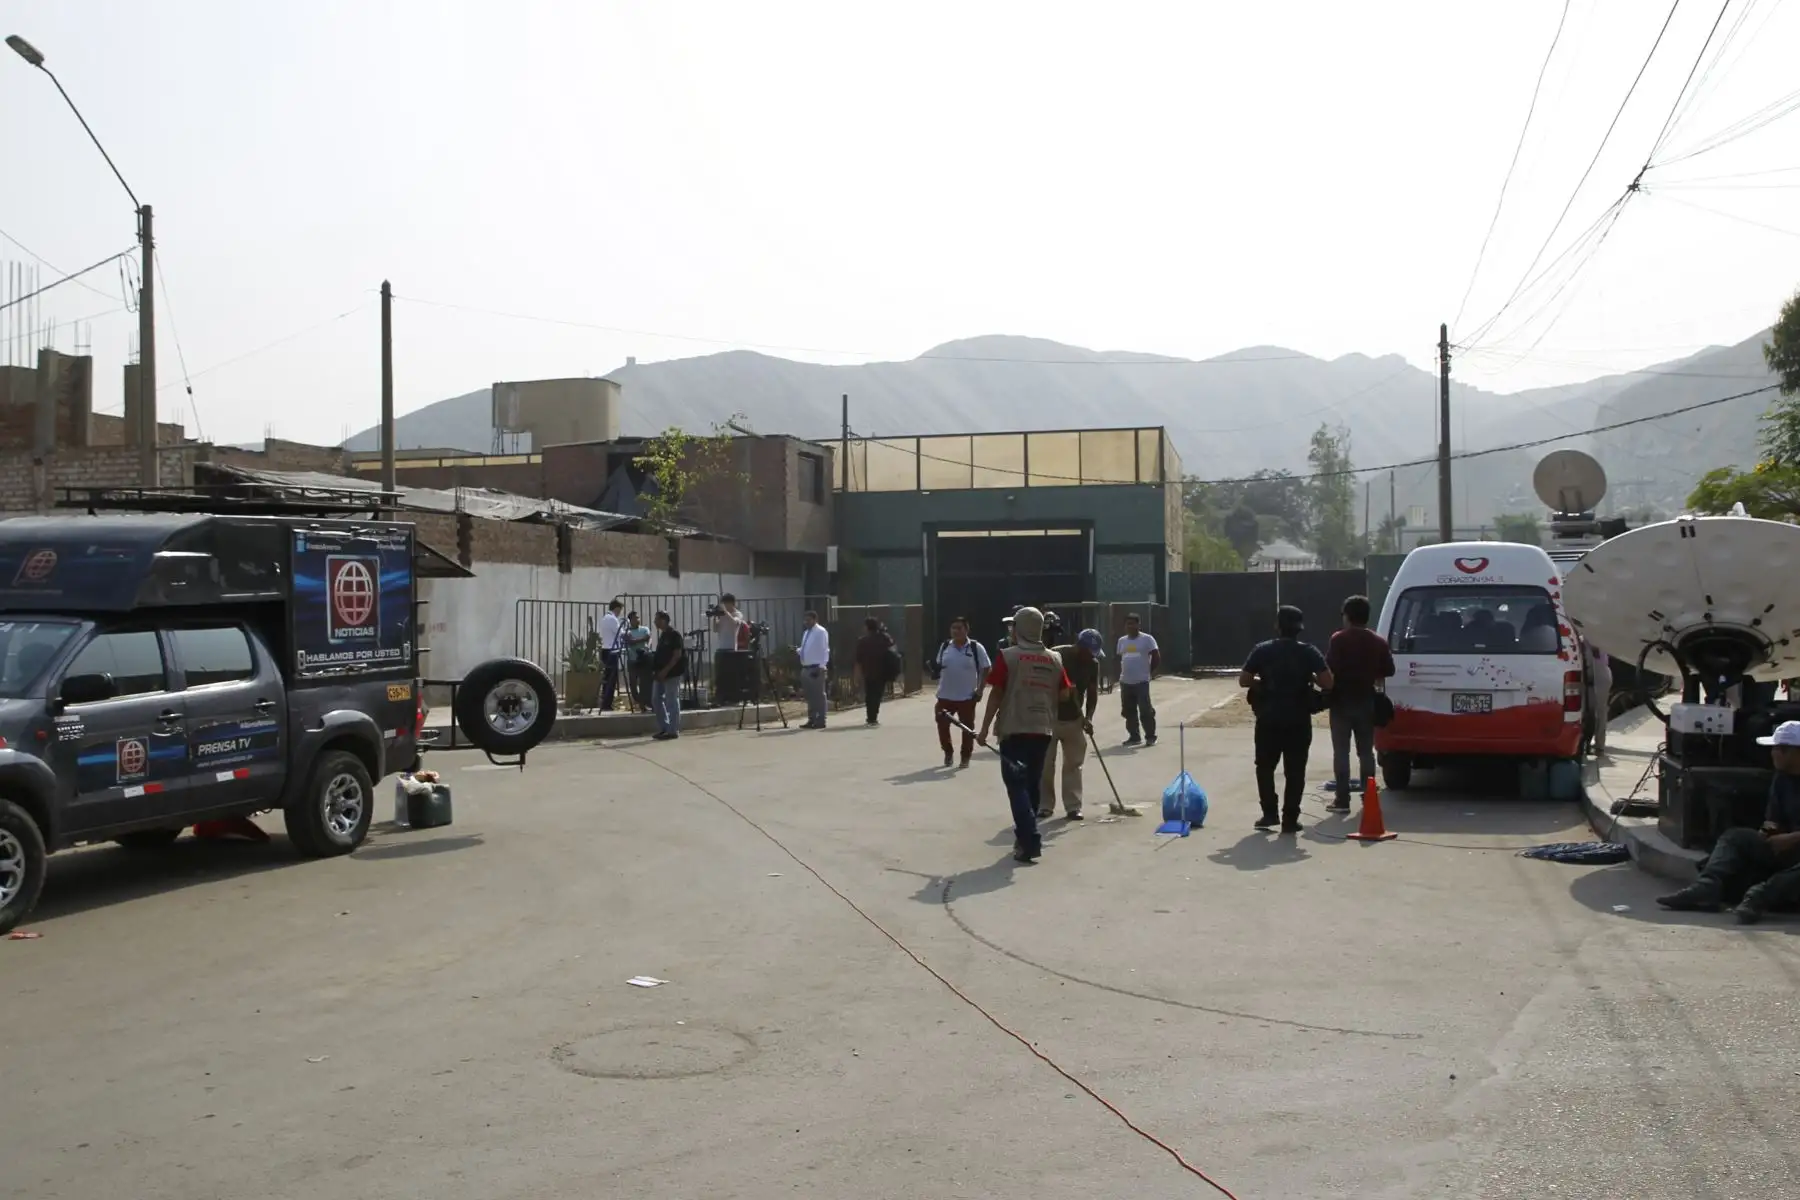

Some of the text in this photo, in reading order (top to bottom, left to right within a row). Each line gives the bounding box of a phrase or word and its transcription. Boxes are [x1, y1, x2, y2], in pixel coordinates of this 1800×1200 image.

[334, 626, 375, 638] NOTICIAS
[306, 648, 400, 662] HABLAMOS POR USTED
[197, 737, 252, 756] PRENSA TV
